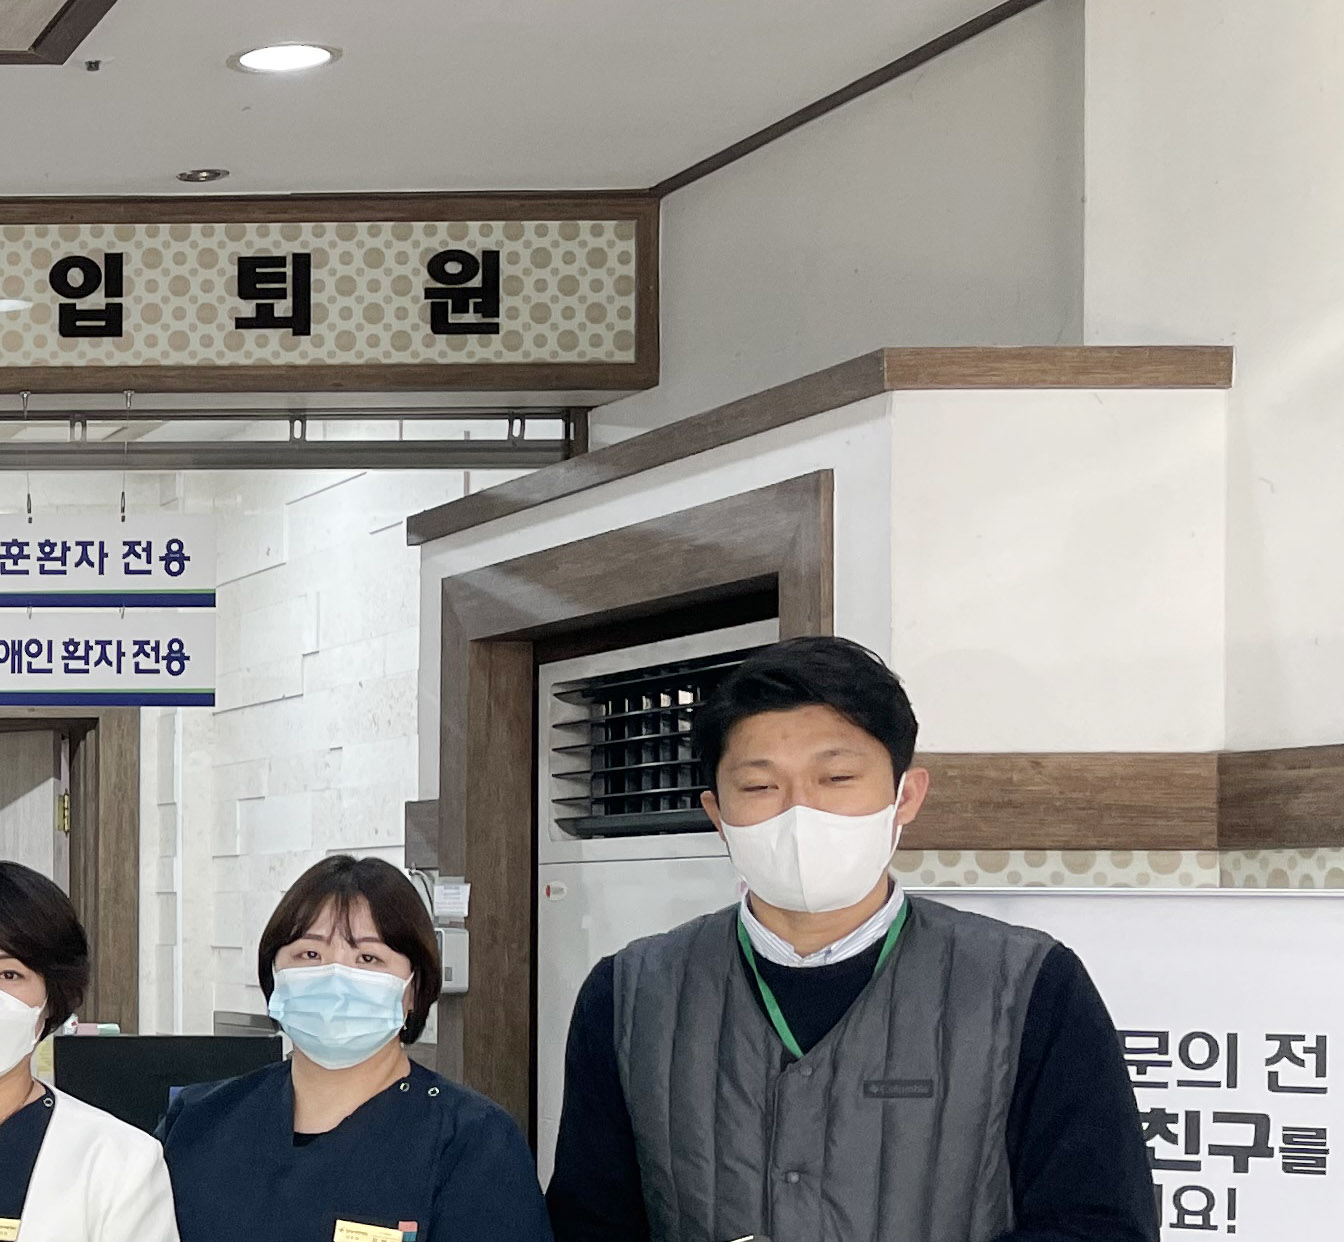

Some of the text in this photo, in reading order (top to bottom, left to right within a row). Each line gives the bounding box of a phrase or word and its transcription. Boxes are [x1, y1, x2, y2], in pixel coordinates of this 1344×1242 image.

[121, 538, 191, 577] 전용
[61, 637, 125, 675] 환자
[132, 637, 191, 676] 전용
